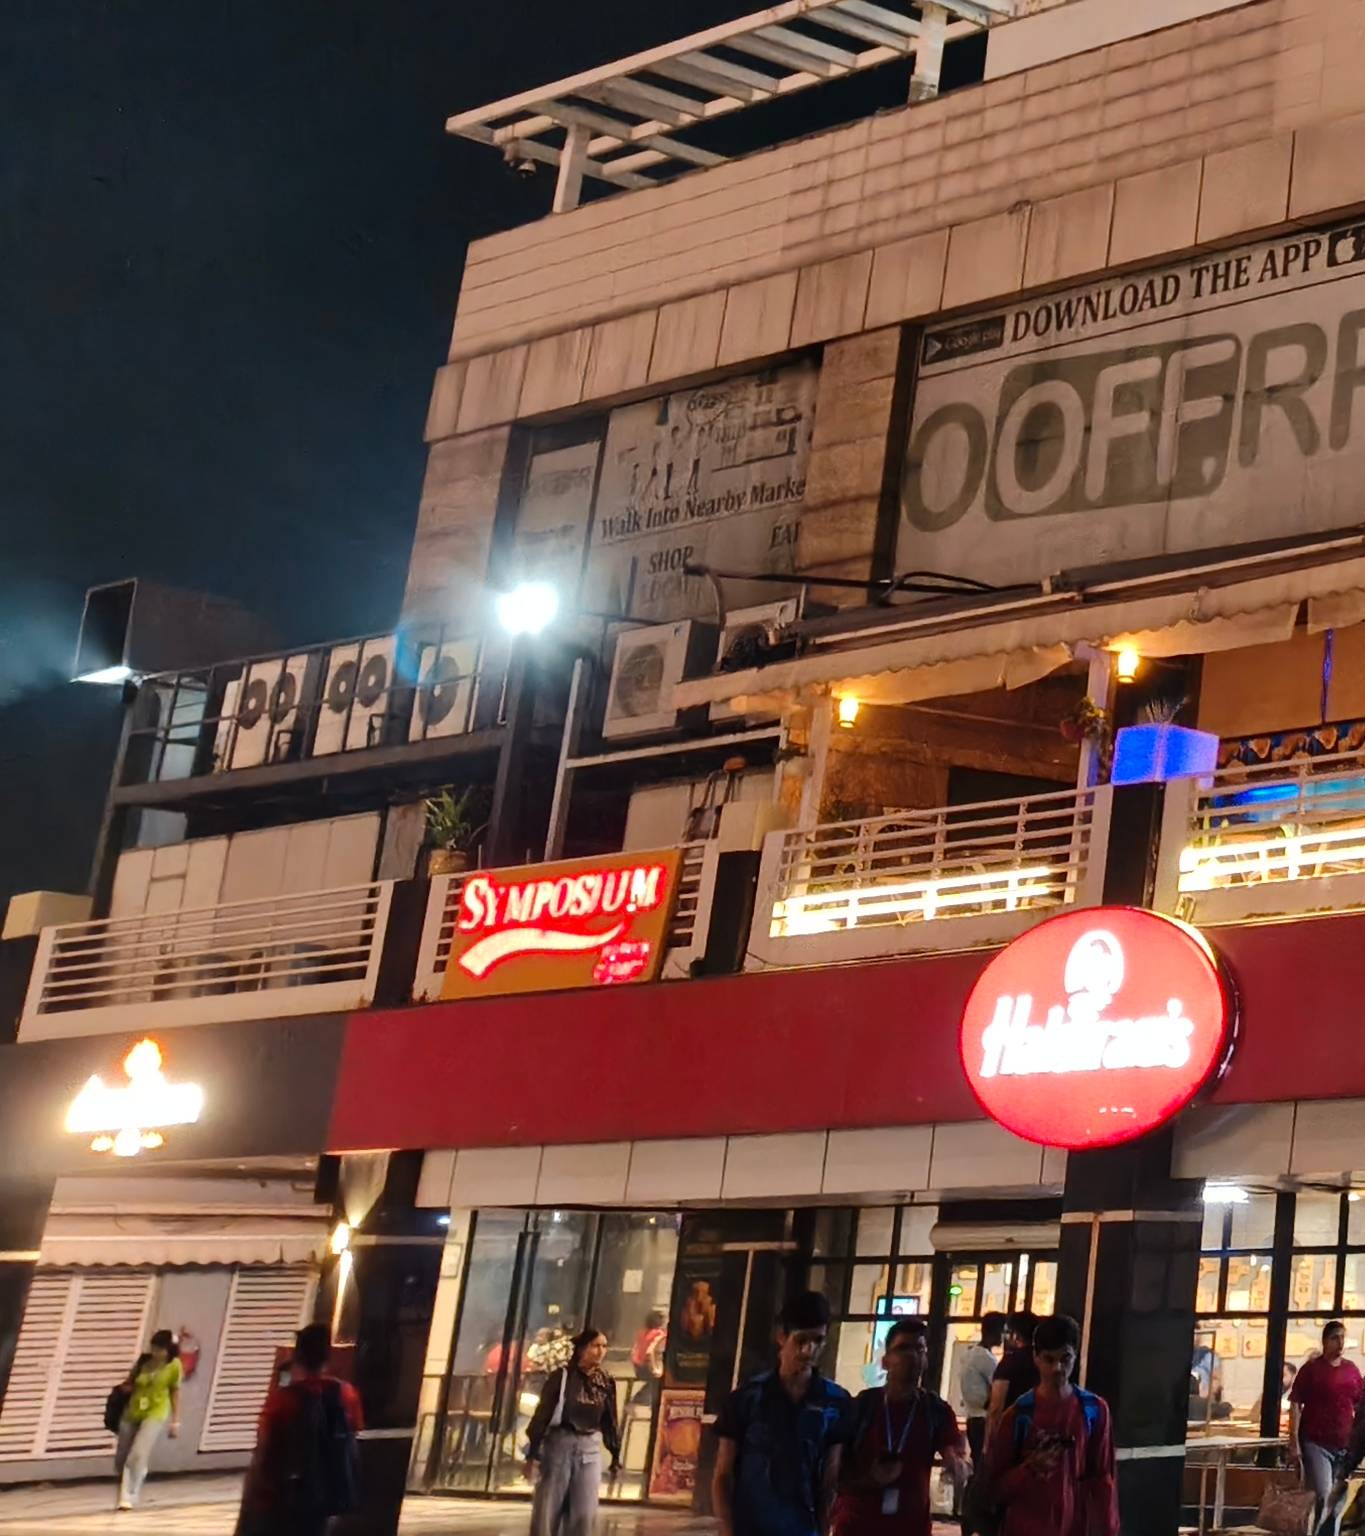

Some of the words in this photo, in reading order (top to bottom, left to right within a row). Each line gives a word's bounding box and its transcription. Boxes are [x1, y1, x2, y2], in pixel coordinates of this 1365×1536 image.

[1010, 274, 1181, 344] DOWNLOAD
[1189, 254, 1252, 300] THE
[1257, 238, 1323, 283] APP
[685, 489, 746, 518] Nearby
[649, 546, 694, 574] SHOP
[458, 866, 662, 930] SYMPOSIUM
